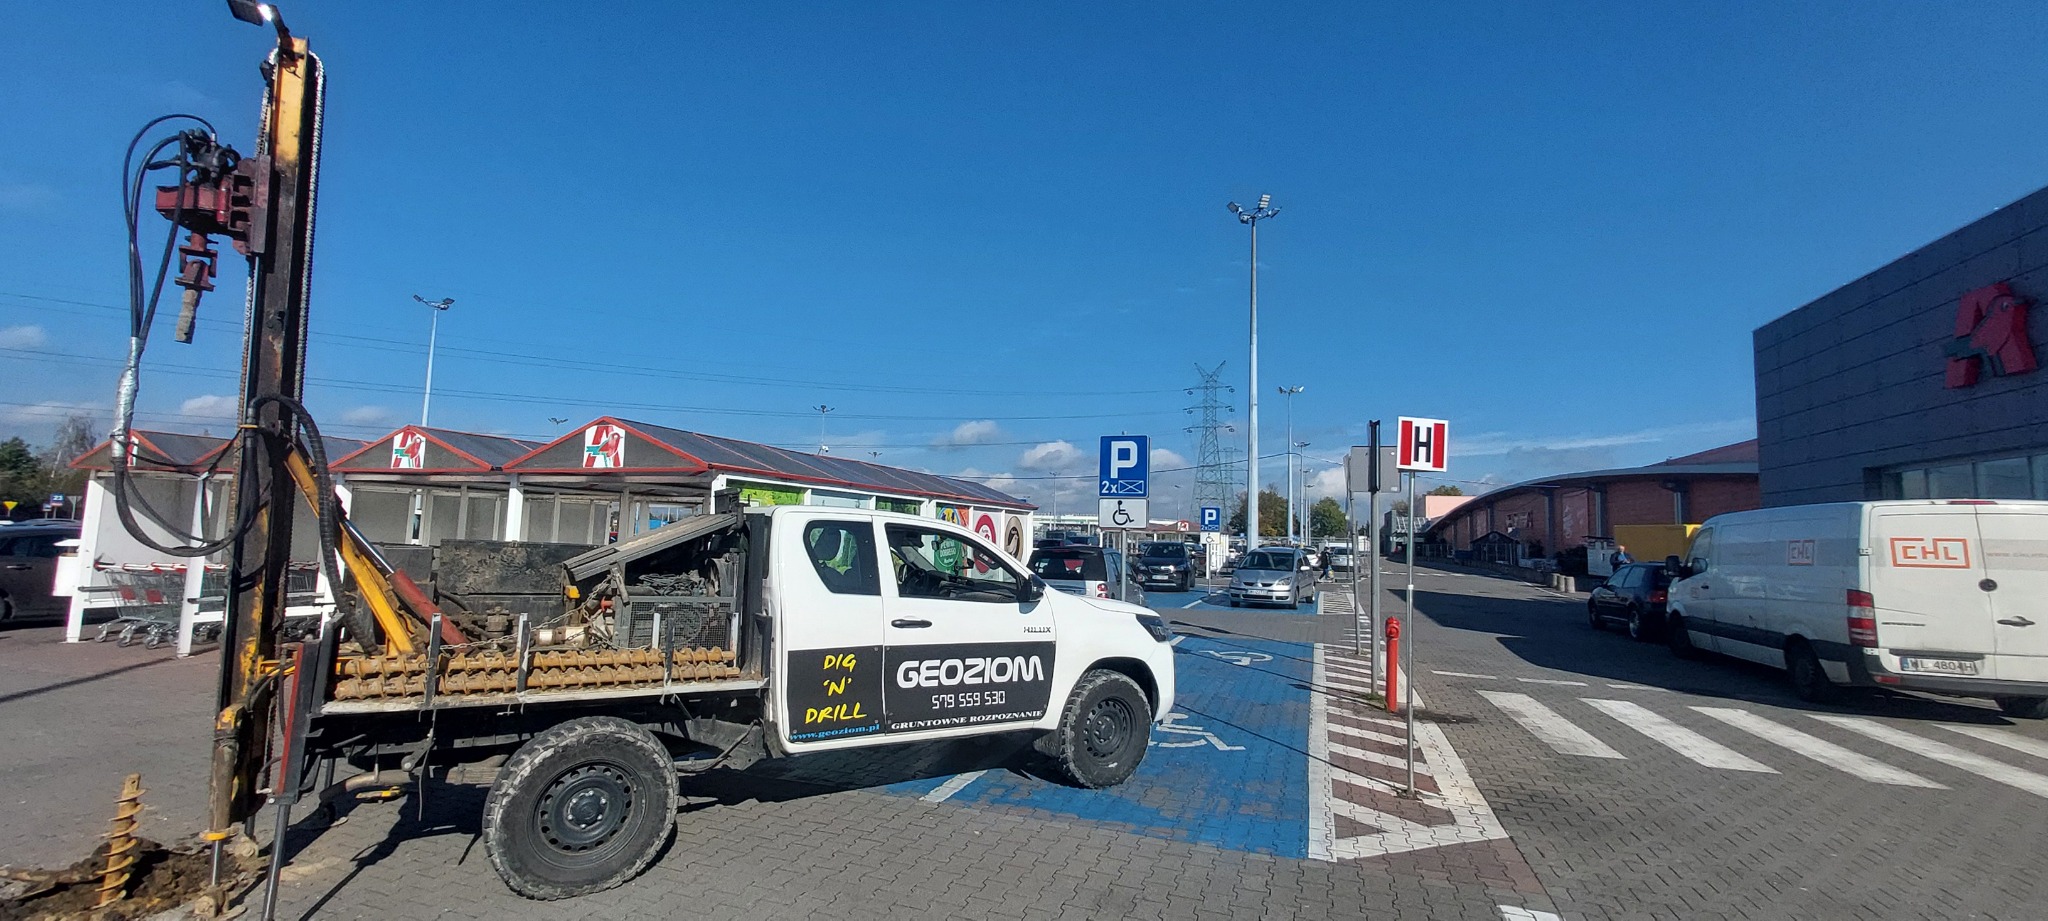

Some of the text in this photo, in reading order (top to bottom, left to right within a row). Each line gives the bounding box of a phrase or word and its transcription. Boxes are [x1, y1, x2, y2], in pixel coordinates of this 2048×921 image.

[1414, 426, 1432, 462] H
[1110, 440, 1138, 478] P
[1101, 481, 1118, 494] 2x
[1204, 509, 1217, 525] P
[823, 653, 857, 672] DIG
[896, 655, 1044, 689] GEOZIOM
[931, 690, 1006, 710] 579 559 530
[805, 701, 868, 725] DRILL
[891, 709, 1043, 731] GRUNTOWNE ROZPOZNANIE
[789, 723, 881, 742] www.geoziom.pl
